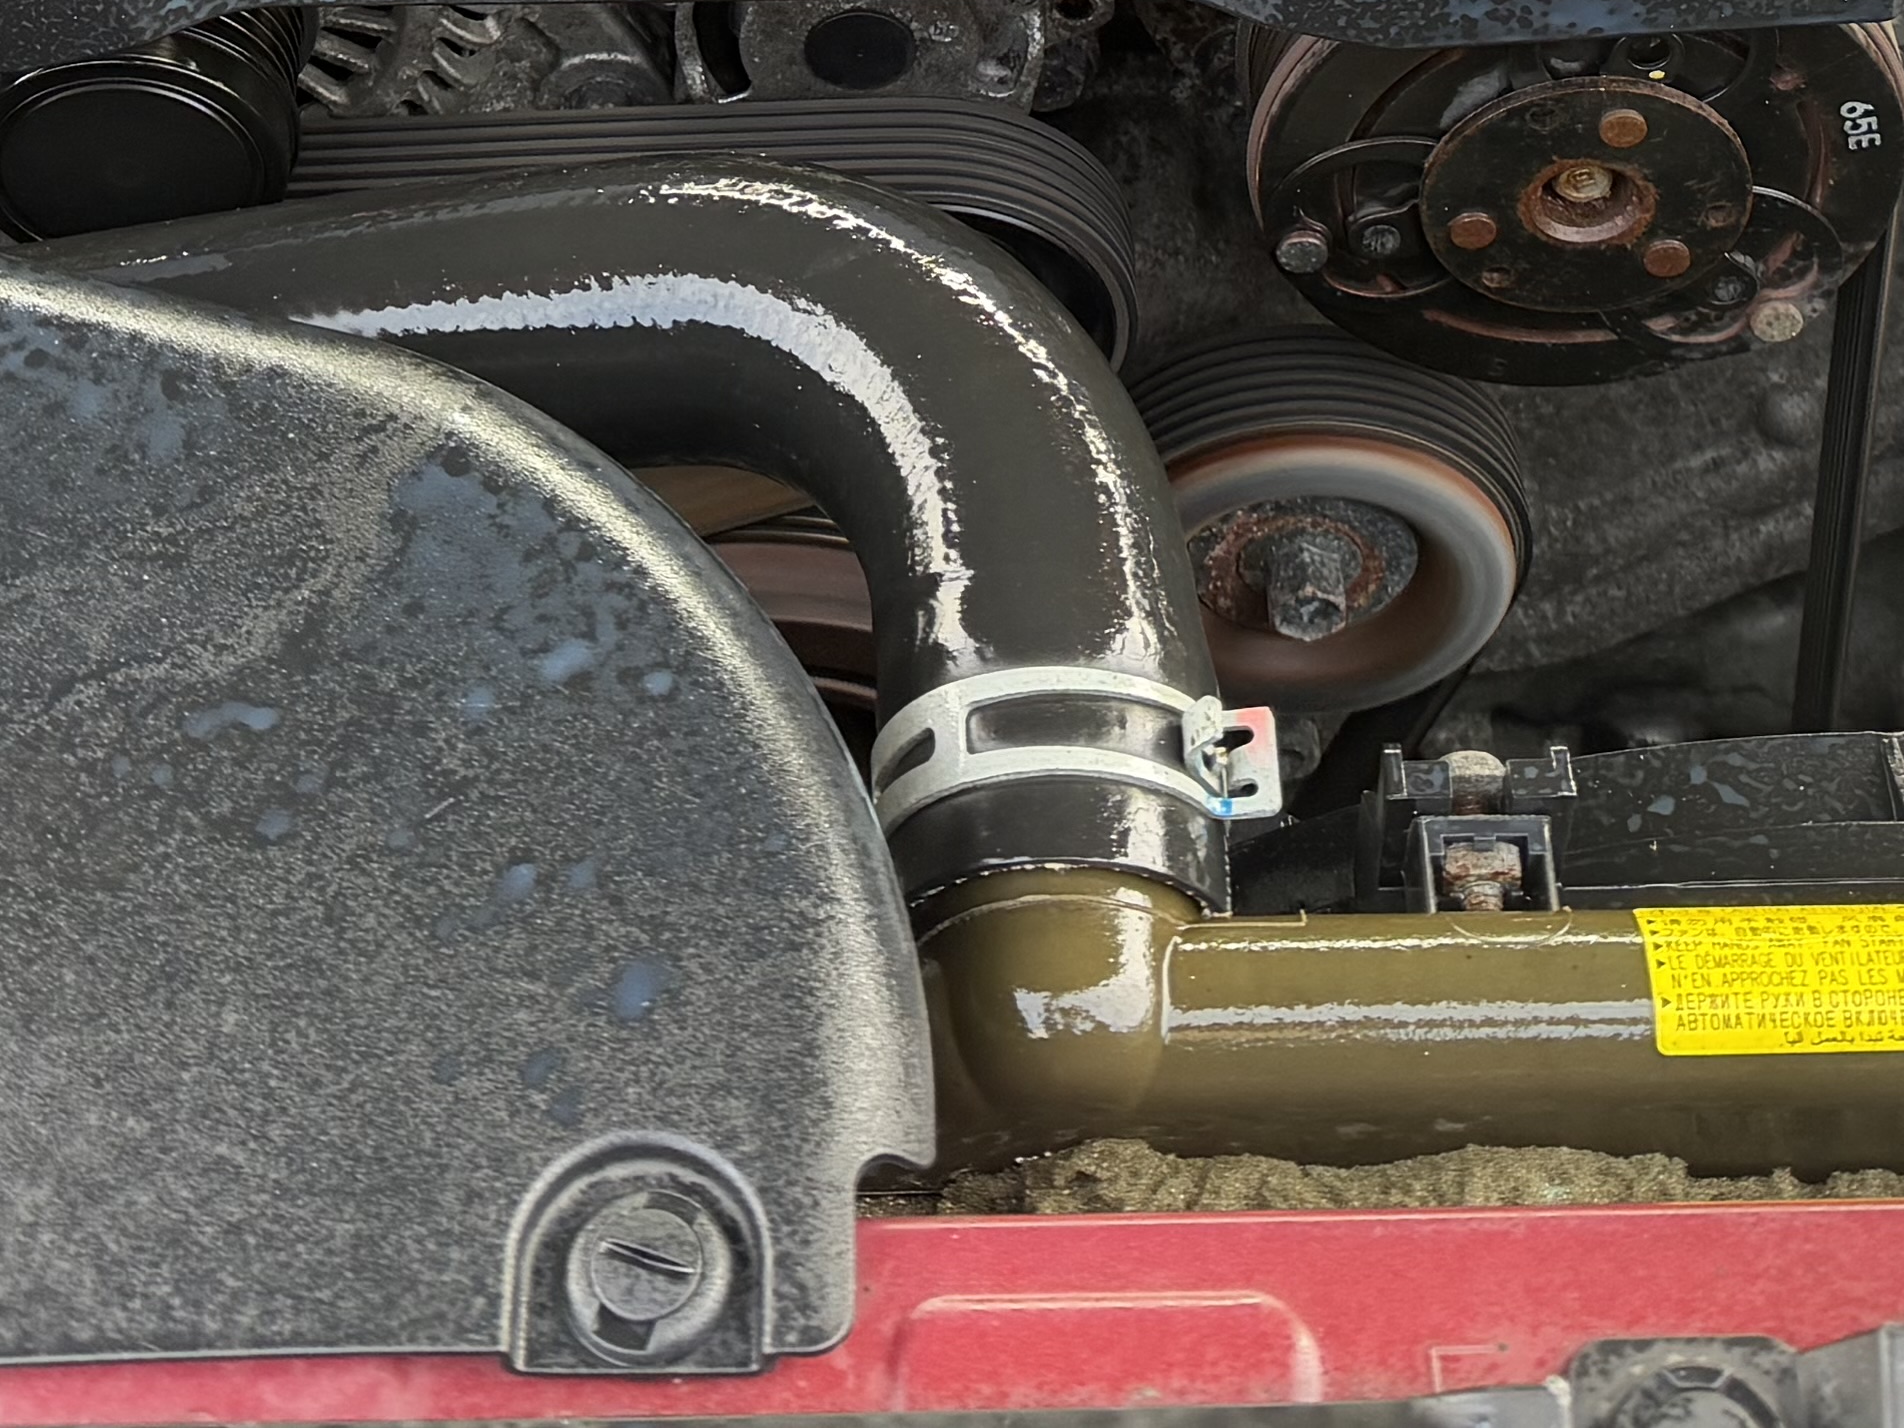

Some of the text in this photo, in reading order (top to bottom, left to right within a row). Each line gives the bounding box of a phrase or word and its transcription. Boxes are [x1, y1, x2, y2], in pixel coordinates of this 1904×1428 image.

[1840, 101, 1882, 150] 65E
[1668, 954, 1685, 971] LE
[1783, 952, 1804, 968] DU
[1721, 969, 1809, 989] APPROCHEZ
[1817, 969, 1849, 987] PAS
[1856, 967, 1888, 986] LES
[1675, 992, 1753, 1012] ДЕРЖИТЕ
[1812, 991, 1823, 1009] В
[1675, 1010, 1838, 1032] АВТОМАТИЧЕСКОЕ
